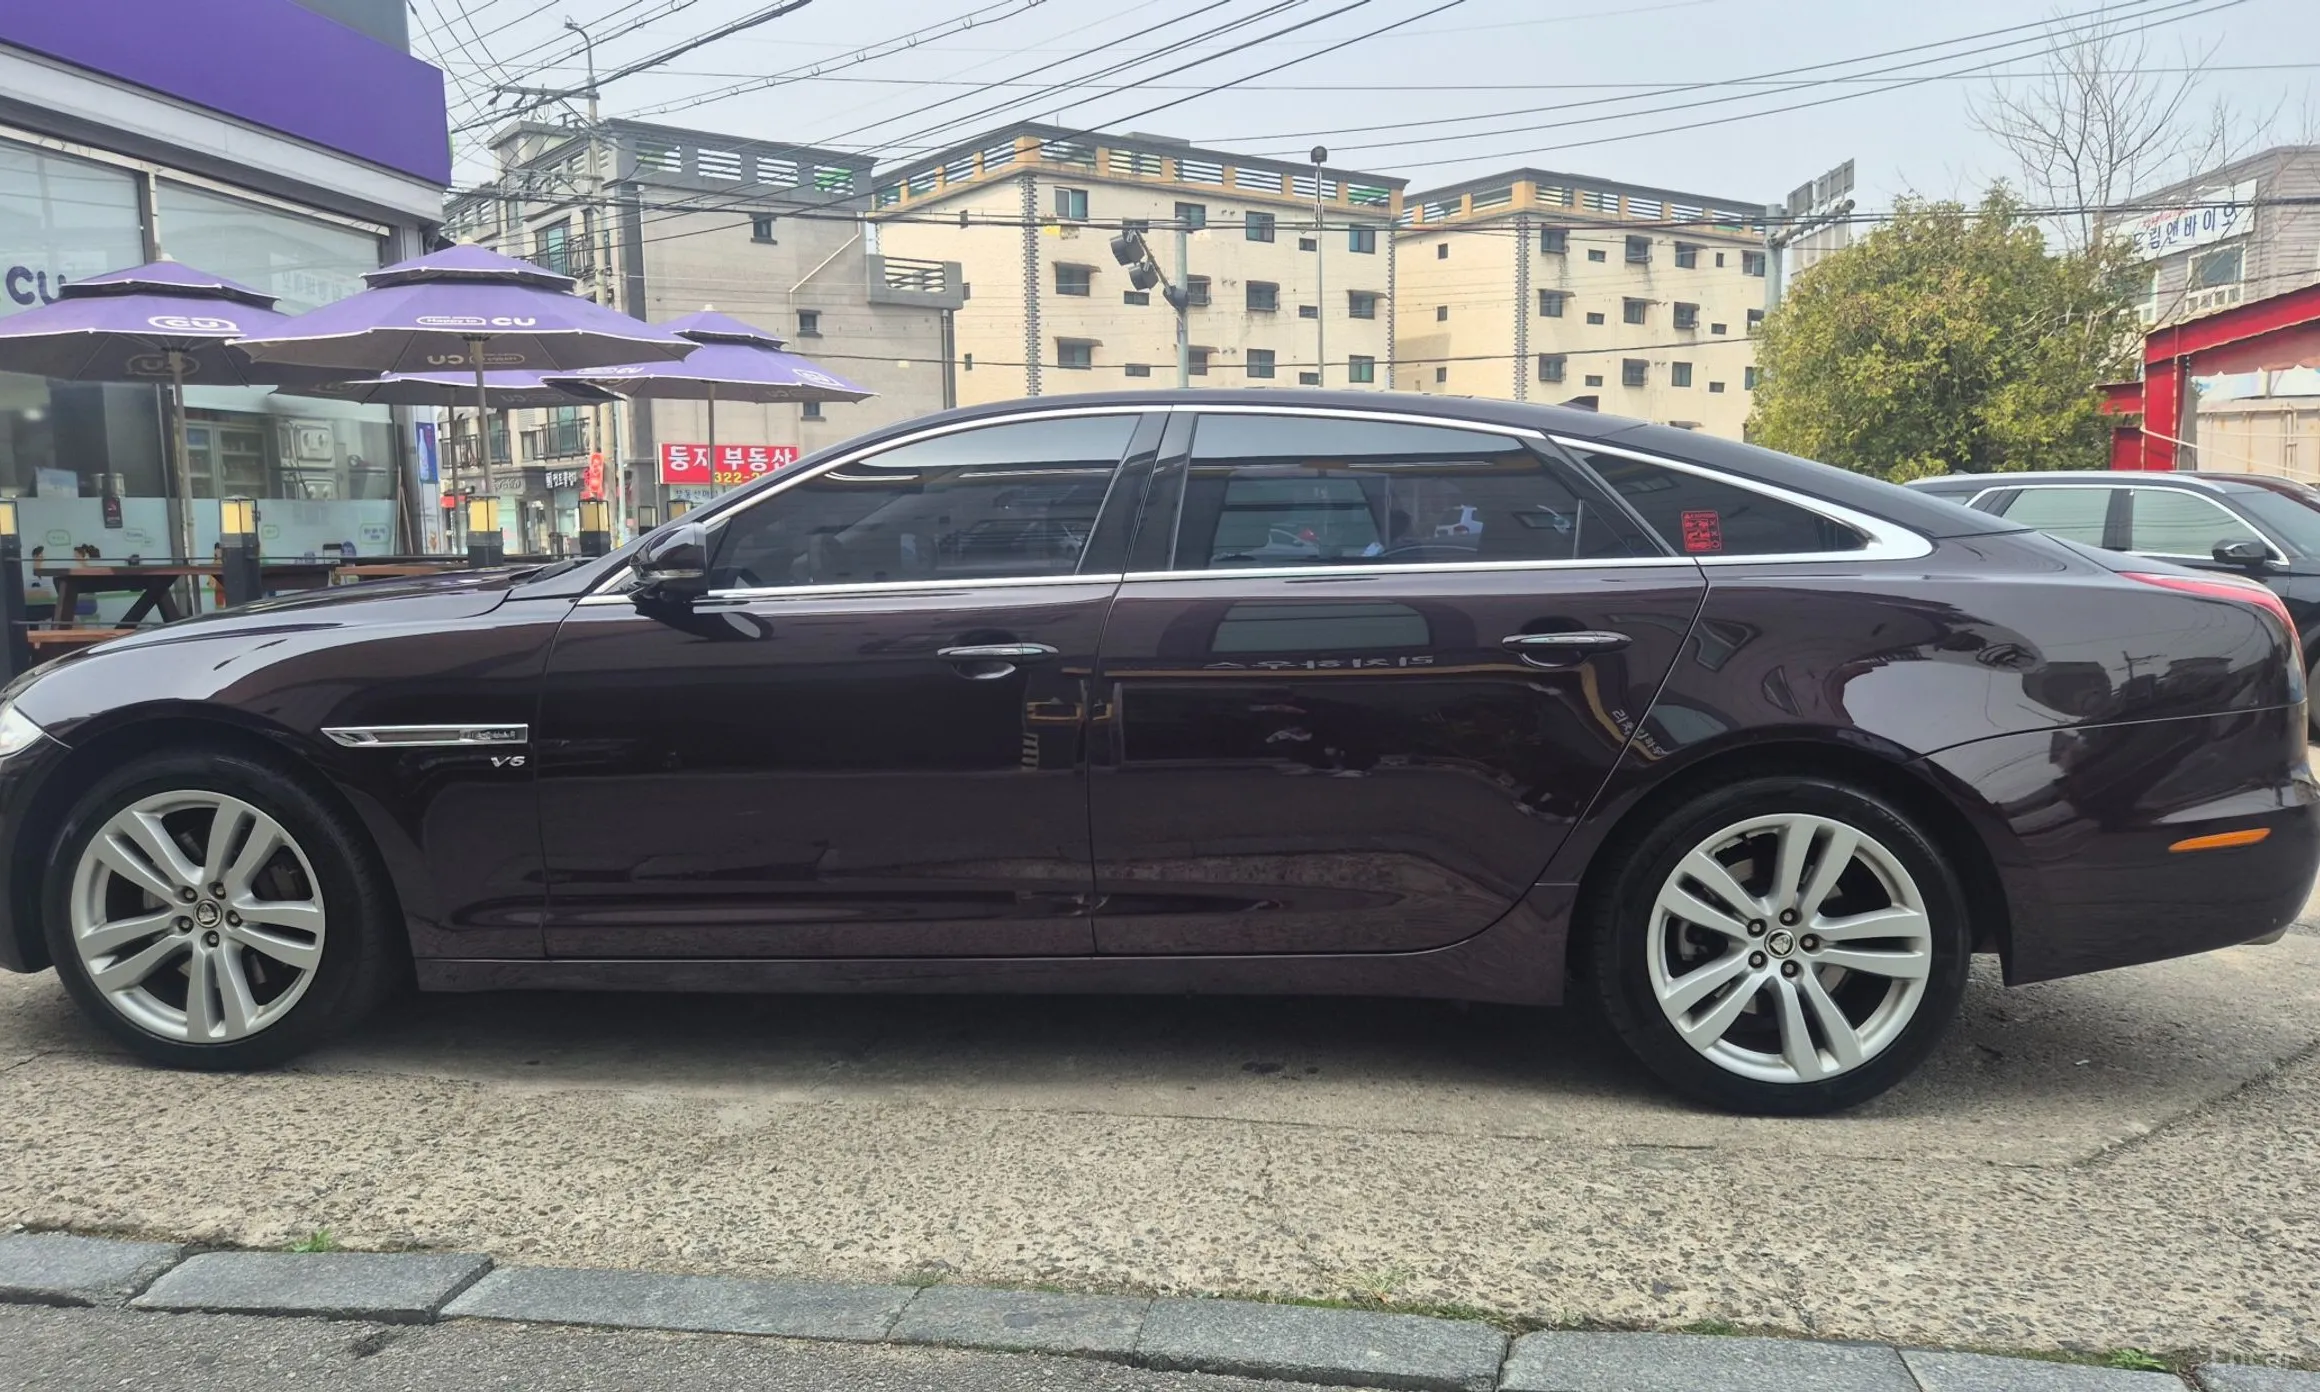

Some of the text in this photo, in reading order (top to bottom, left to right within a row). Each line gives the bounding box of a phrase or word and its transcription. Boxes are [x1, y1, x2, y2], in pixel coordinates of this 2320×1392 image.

[6, 266, 66, 305] CU
[164, 319, 219, 330] CU
[491, 317, 536, 326] CU
[667, 445, 792, 472] 둥지 부동산
[491, 755, 526, 768] V6
